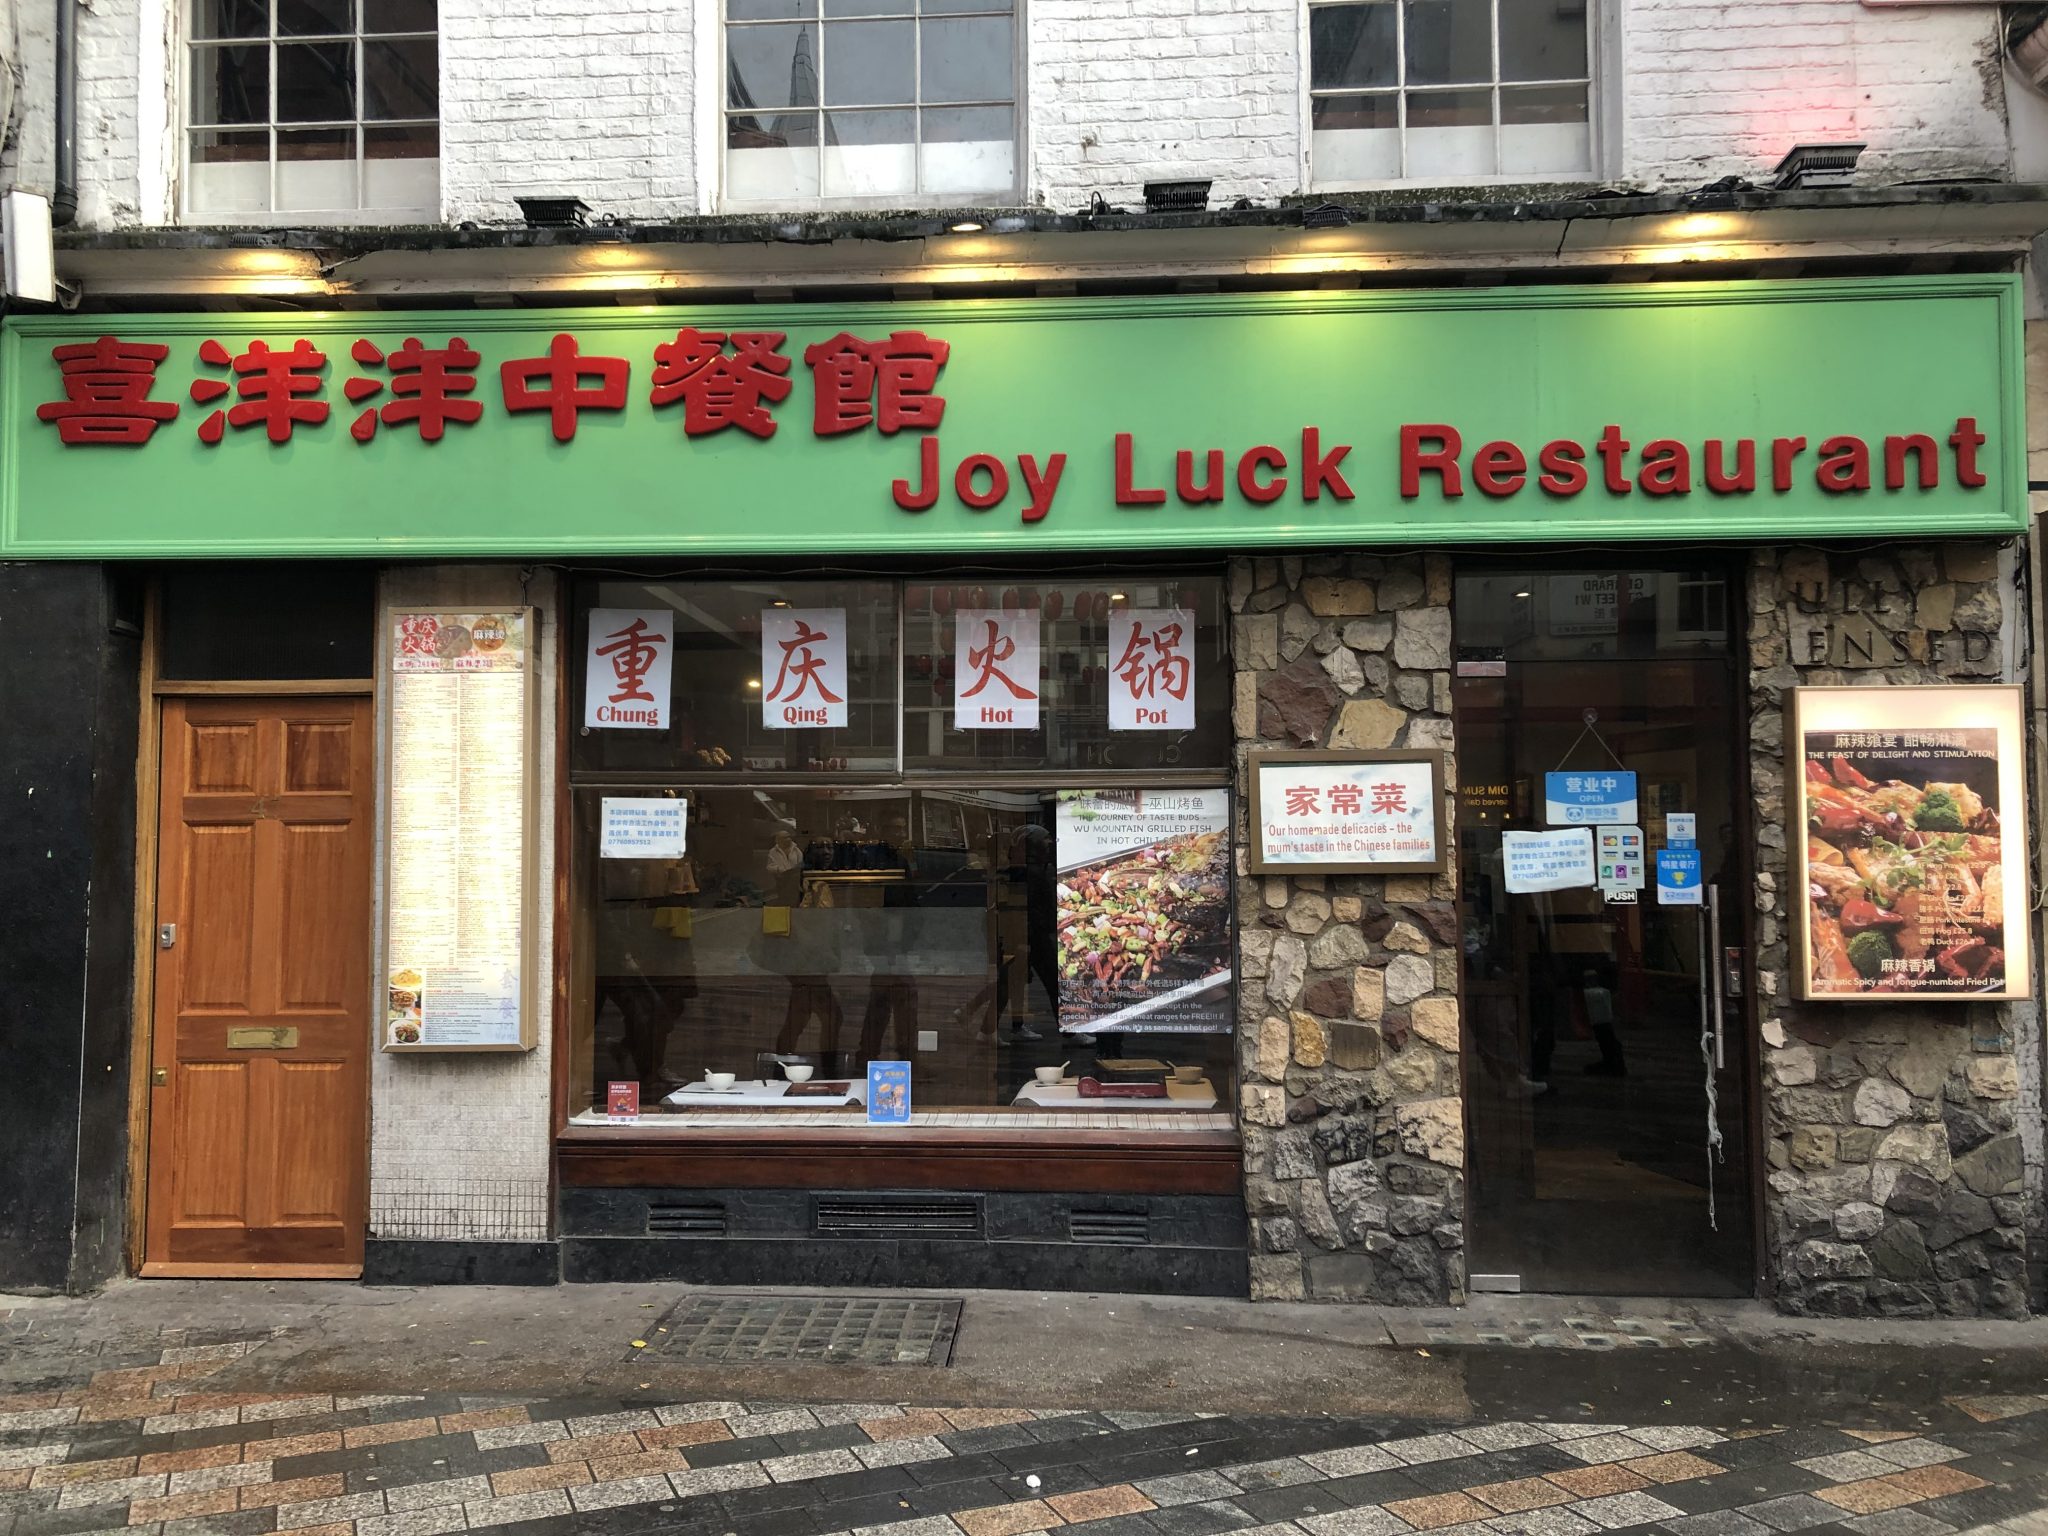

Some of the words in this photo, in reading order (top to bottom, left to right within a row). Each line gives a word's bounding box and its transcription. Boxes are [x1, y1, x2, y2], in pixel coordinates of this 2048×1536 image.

[37, 326, 950, 444] 喜洋洋中餐館
[892, 435, 1067, 521] Joy
[1115, 427, 1355, 504] Luck
[1400, 417, 1986, 498] Restaurant
[595, 616, 666, 703] 重
[766, 620, 844, 704] 庆
[961, 620, 1037, 700] 火
[1112, 621, 1190, 702] 锅
[597, 706, 658, 727] Chung
[783, 707, 828, 726] Qing
[980, 706, 1014, 724] Hot
[1135, 707, 1169, 724] Pot
[1808, 751, 1825, 759] THE
[1827, 751, 1854, 759] FEAST
[1857, 751, 1869, 759] OF
[1872, 751, 1909, 759] DELIGHT
[1912, 750, 1931, 758] AND
[1933, 750, 1995, 758] STIMULATION
[1565, 776, 1617, 793] 营业中
[1285, 783, 1408, 816] 家常菜
[1073, 825, 1090, 833] WU
[1093, 825, 1144, 833] MOUNTAIN
[1147, 825, 1187, 833] GRILLED
[1189, 825, 1212, 833] FISH
[1268, 824, 1286, 837] Our
[1287, 823, 1340, 836] homemade
[1341, 822, 1387, 835] delicacies
[1396, 822, 1412, 833] the
[1097, 837, 1107, 845] IN
[1111, 837, 1130, 845] HOT
[1267, 841, 1299, 854] mum's
[1300, 841, 1324, 853] taste
[1326, 840, 1335, 852] in
[1336, 840, 1352, 852] the
[1353, 839, 1391, 851] Chinese
[1392, 838, 1431, 850] families
[1607, 892, 1636, 901] PUSH
[1880, 958, 1936, 974] 麻辣香锅
[1853, 977, 1877, 989] Spicy
[1878, 977, 1894, 986] and
[1896, 977, 1965, 988] Tongue-numbed
[1966, 977, 1986, 986] Fried
[1062, 1013, 1088, 1021] special,
[1202, 1024, 1218, 1033] pot!
